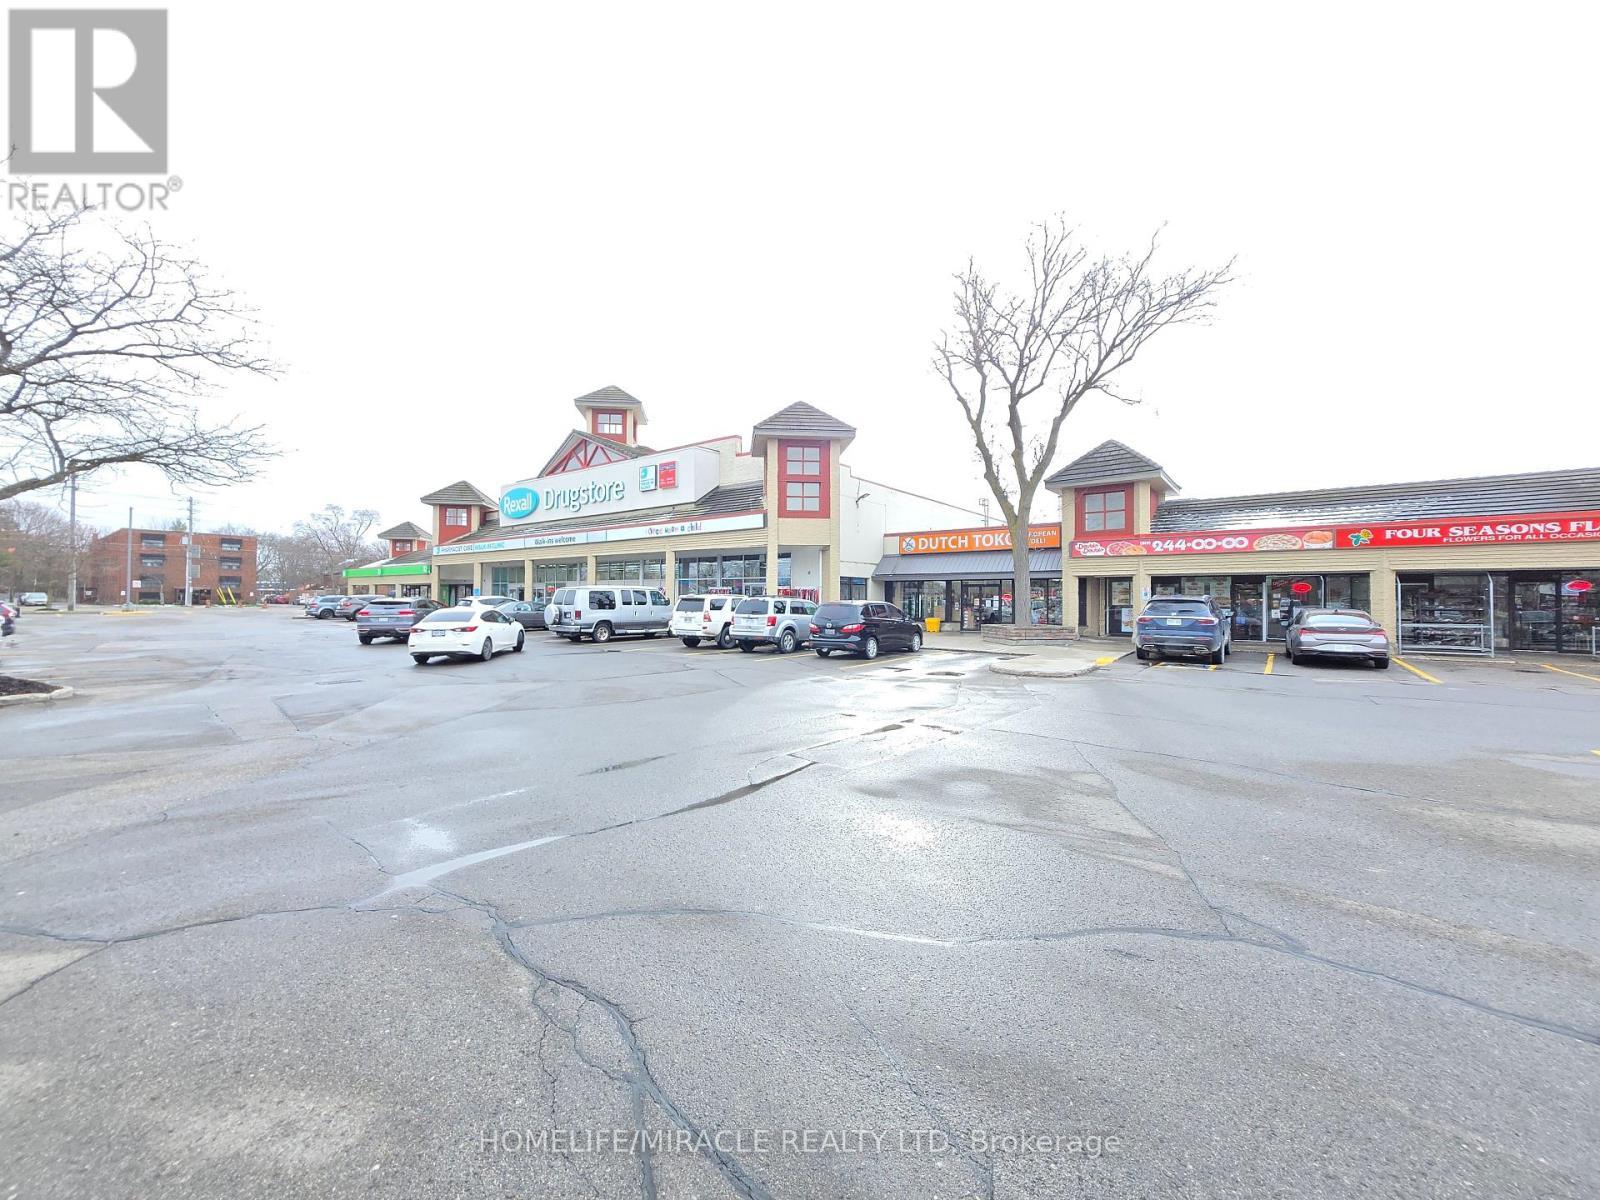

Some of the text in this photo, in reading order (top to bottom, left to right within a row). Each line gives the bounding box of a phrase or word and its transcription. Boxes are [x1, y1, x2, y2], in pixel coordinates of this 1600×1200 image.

[503, 480, 625, 515] Rexall Drugstore
[1385, 527, 1442, 539] FOUR
[1448, 522, 1561, 536] SEASONS
[1443, 534, 1496, 543] FLOWERS
[1498, 533, 1522, 541] FOR
[1525, 532, 1545, 540] ALL
[918, 534, 968, 550] DUTCH
